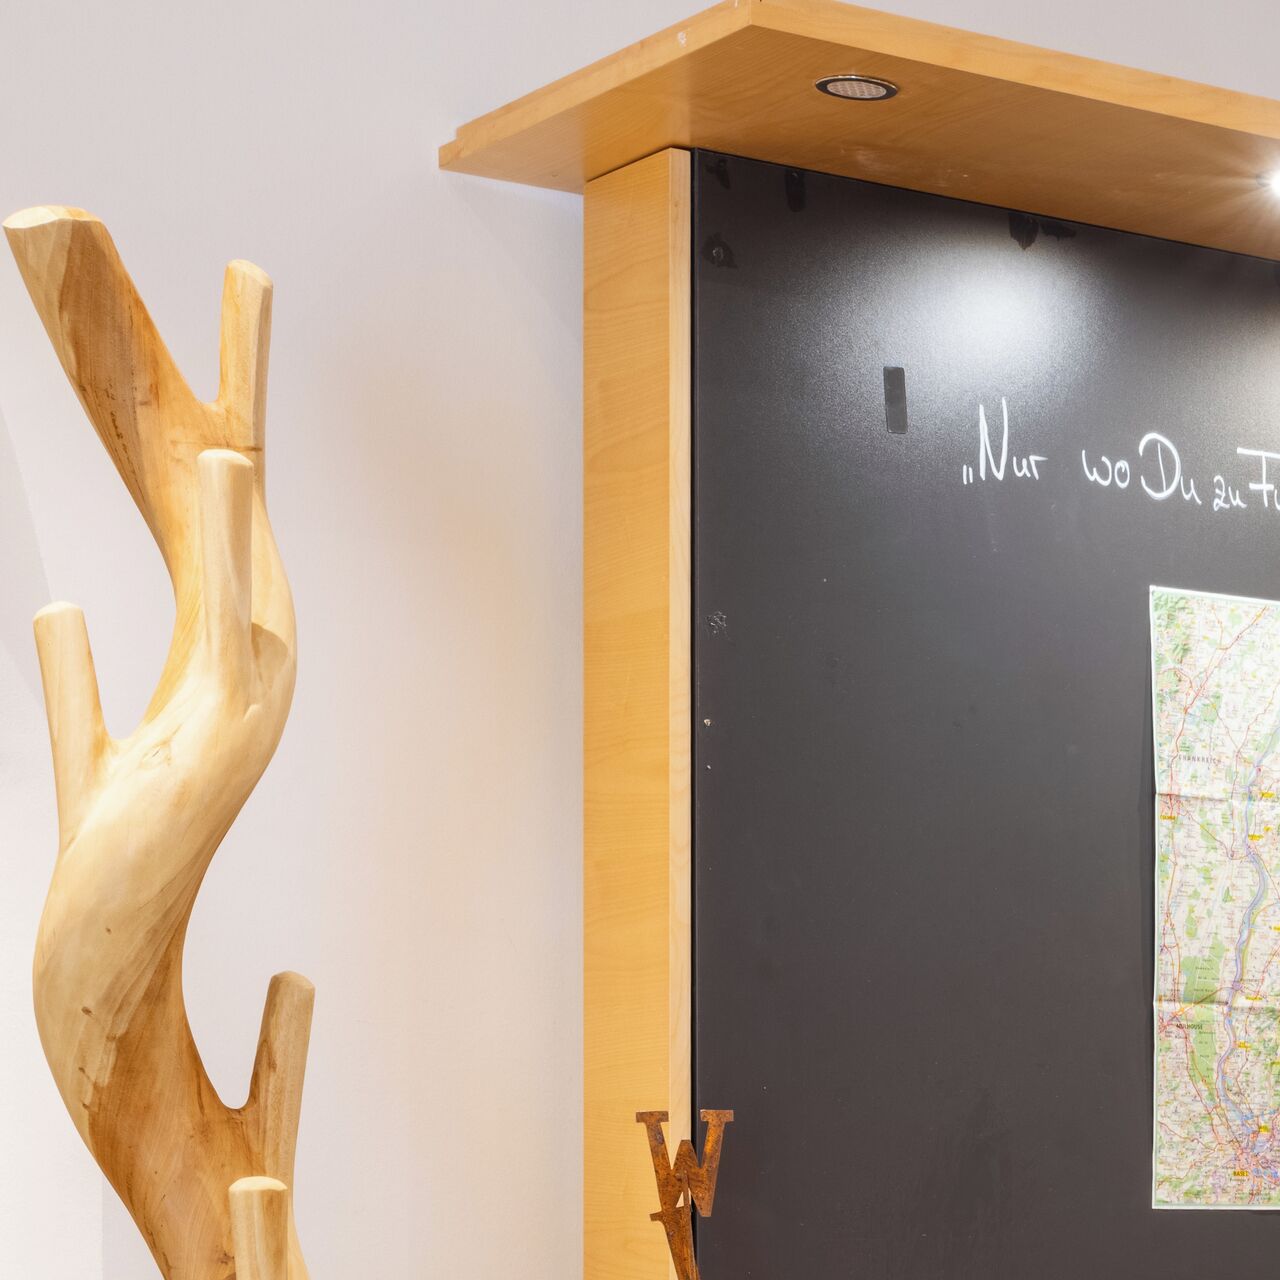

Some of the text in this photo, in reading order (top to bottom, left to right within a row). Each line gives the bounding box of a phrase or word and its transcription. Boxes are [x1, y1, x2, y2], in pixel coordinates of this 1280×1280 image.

[1081, 448, 1131, 489] wo
[1138, 431, 1202, 505] Du
[1212, 474, 1248, 512] zu
